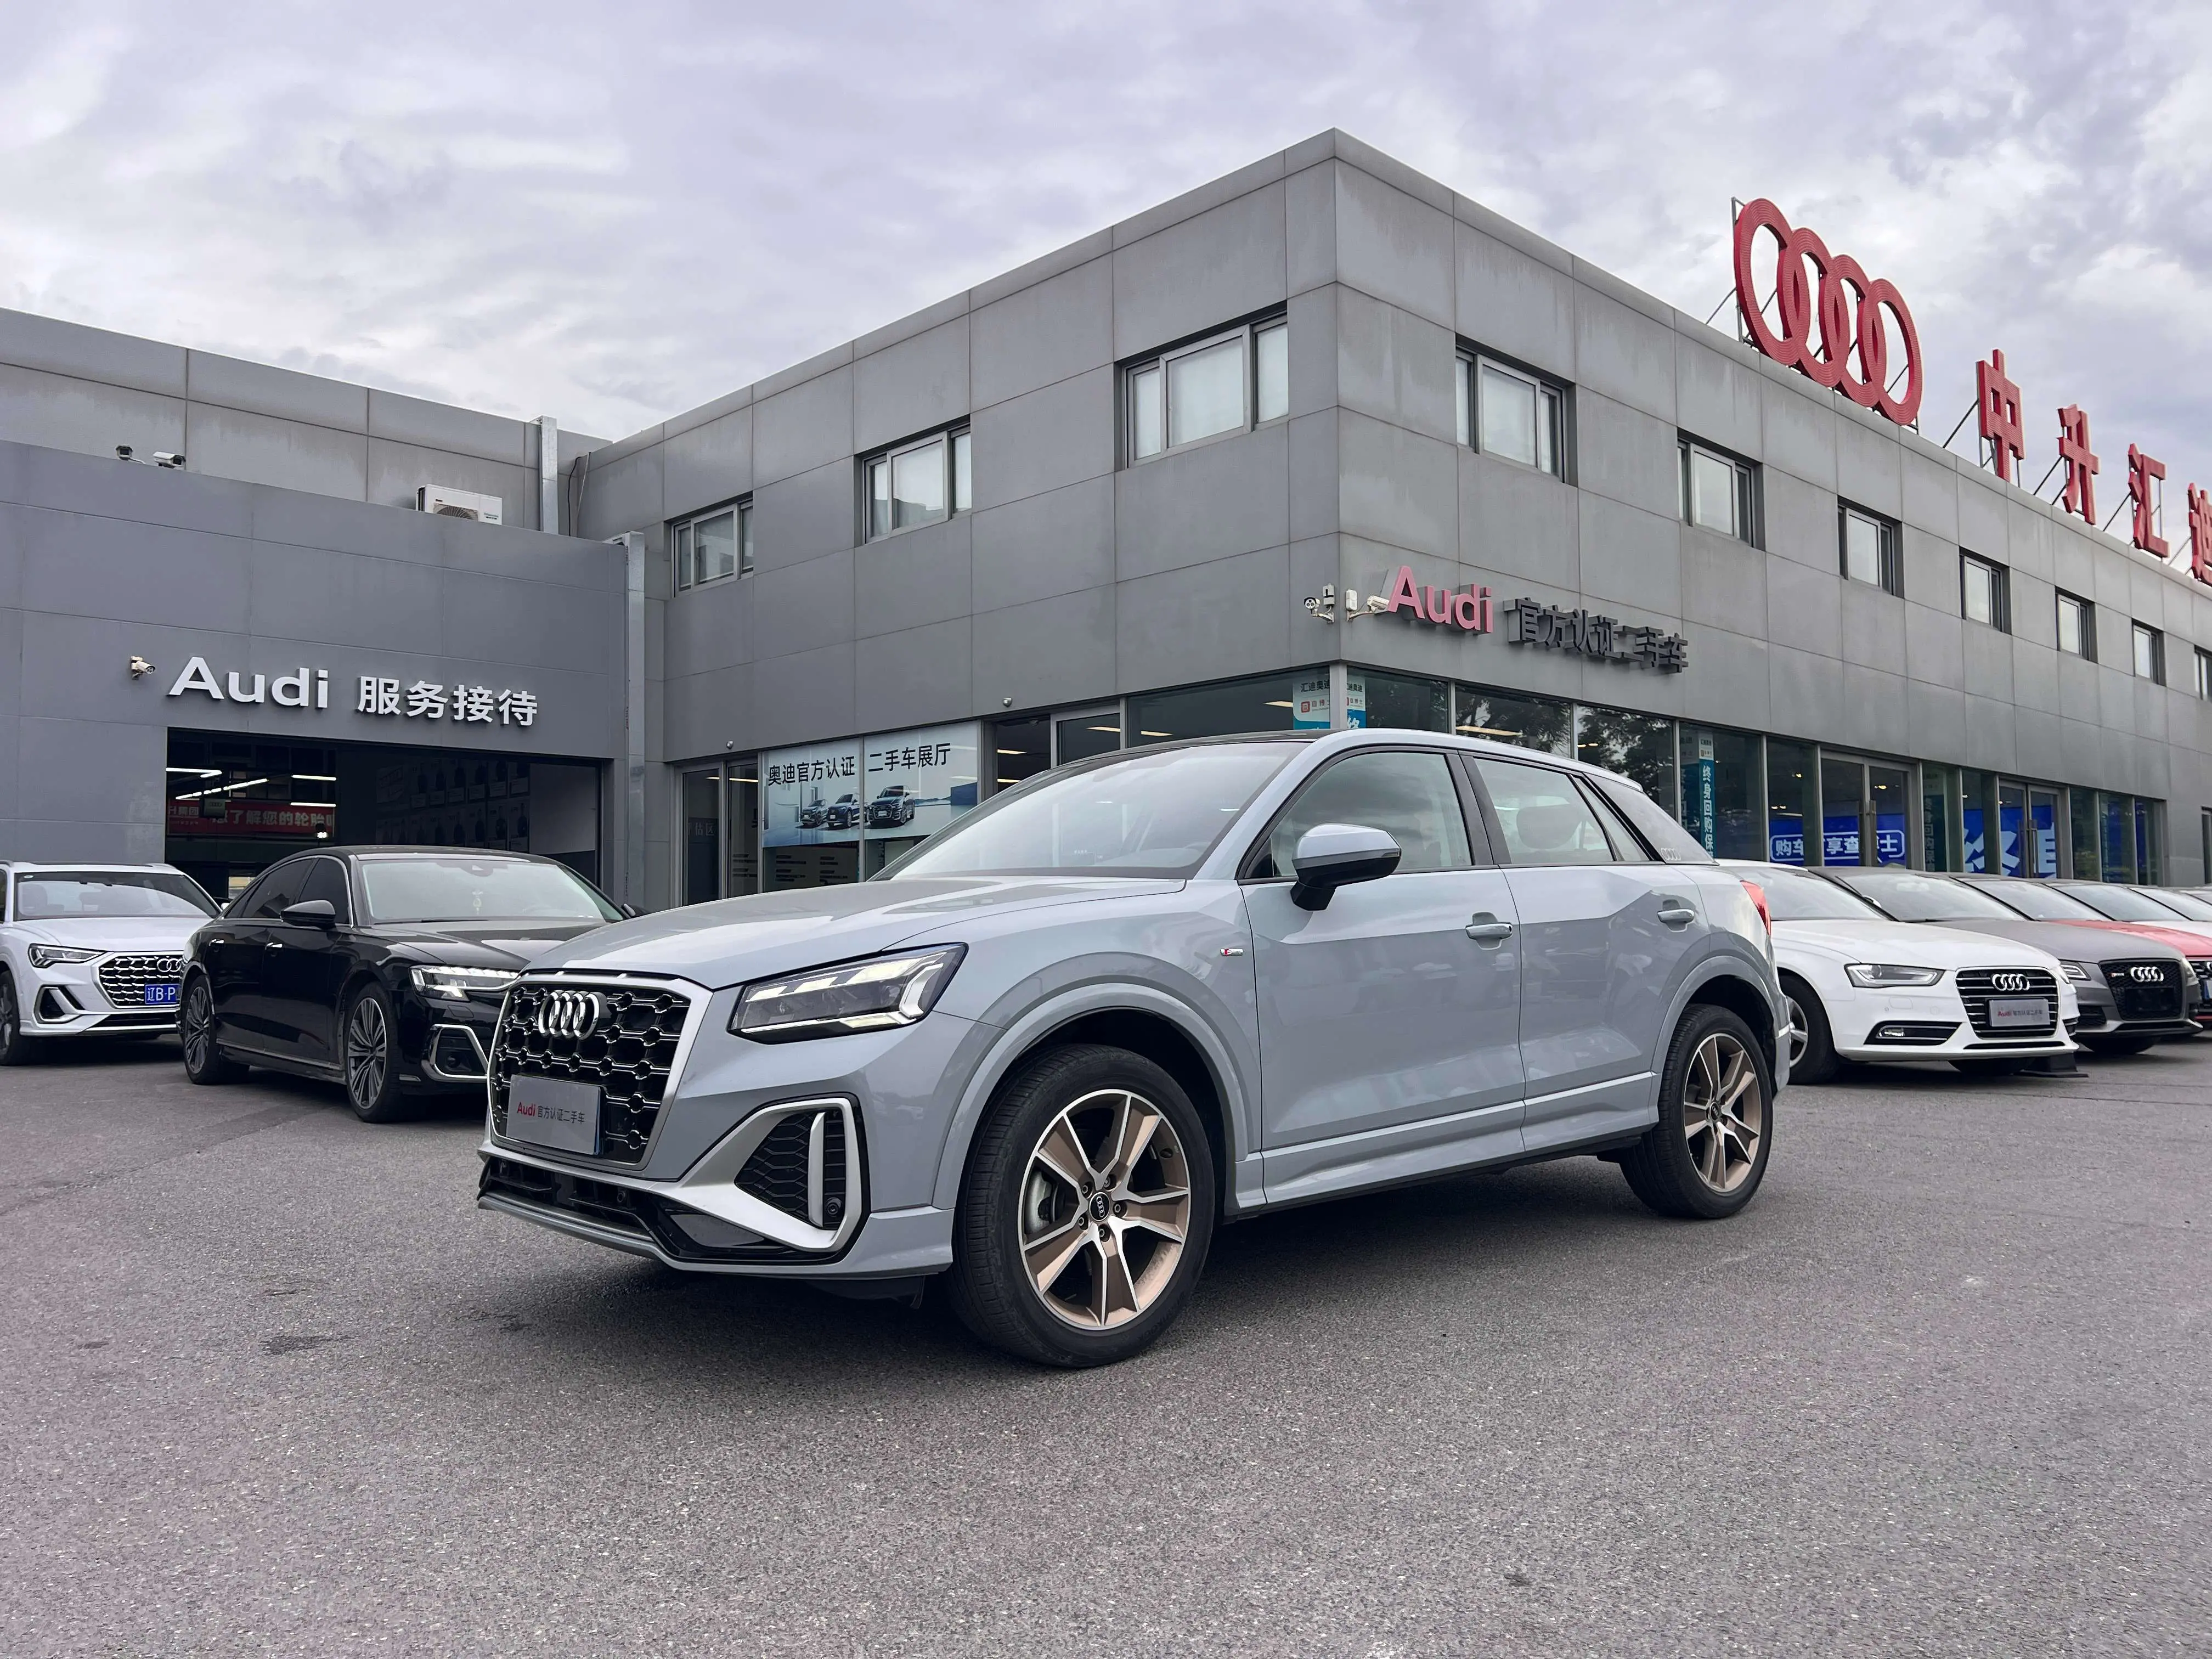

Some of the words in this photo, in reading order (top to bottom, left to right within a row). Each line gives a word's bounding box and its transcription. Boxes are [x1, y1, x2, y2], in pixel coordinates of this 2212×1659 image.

[1387, 566, 1493, 633] Audi
[1510, 597, 1689, 673] 官方认证二手车
[167, 657, 329, 708] Audi
[356, 676, 538, 726] 服务接待
[768, 756, 855, 786] 奥迪官方认证
[868, 743, 951, 772] 二手车展厅
[1775, 834, 1898, 856] 购车享查士
[517, 1102, 536, 1116] Audi
[538, 1105, 585, 1124] 官方认证二手车
